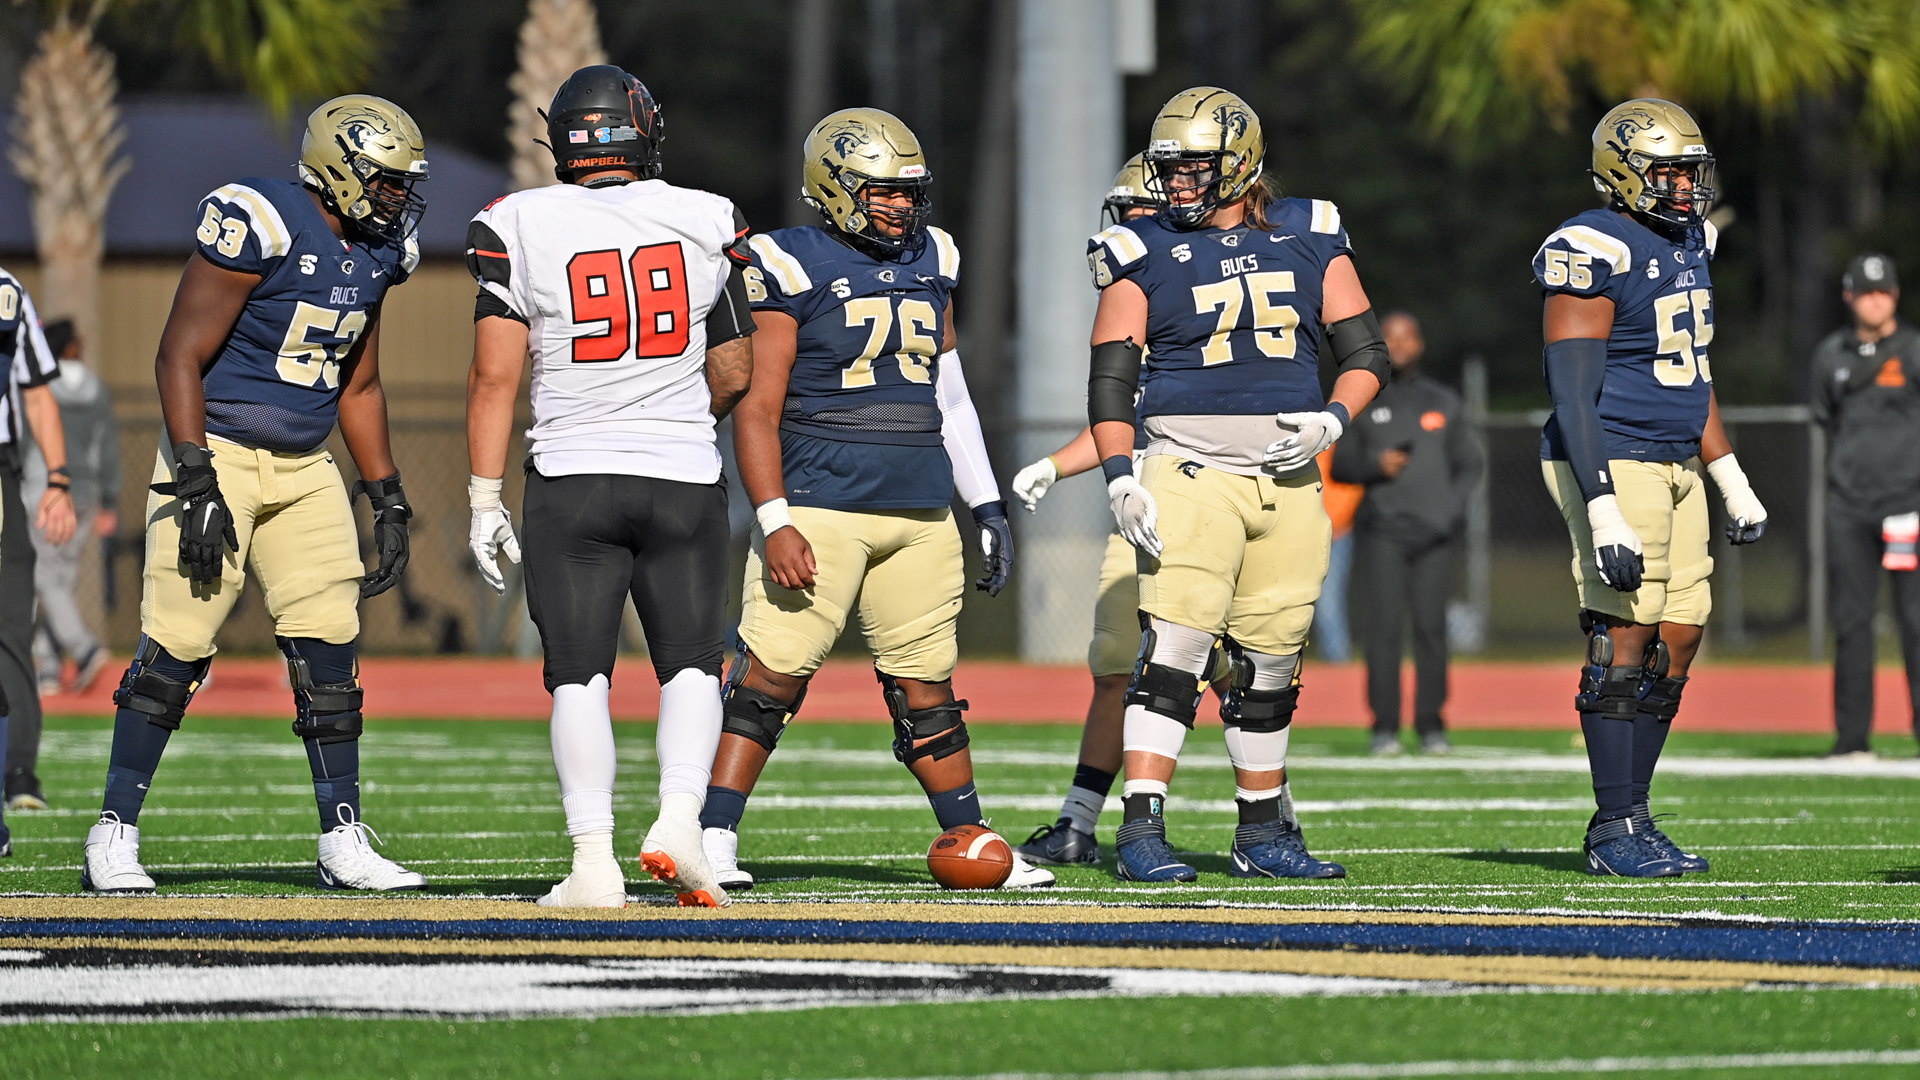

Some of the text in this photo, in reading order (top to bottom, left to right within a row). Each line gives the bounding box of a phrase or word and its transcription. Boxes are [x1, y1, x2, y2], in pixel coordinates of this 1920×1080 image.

[567, 157, 627, 168] CAMPBELL
[196, 202, 249, 259] 53
[742, 265, 768, 303] 6
[1087, 247, 1114, 289] 75
[1220, 254, 1259, 277] BUCS
[1544, 248, 1593, 290] 55
[1675, 268, 1696, 289] BUCS
[329, 286, 358, 305] BUCS
[566, 241, 691, 364] 98
[1191, 271, 1300, 366] 75
[1653, 288, 1714, 387] 55
[275, 300, 367, 389] 53
[841, 296, 937, 389] 76
